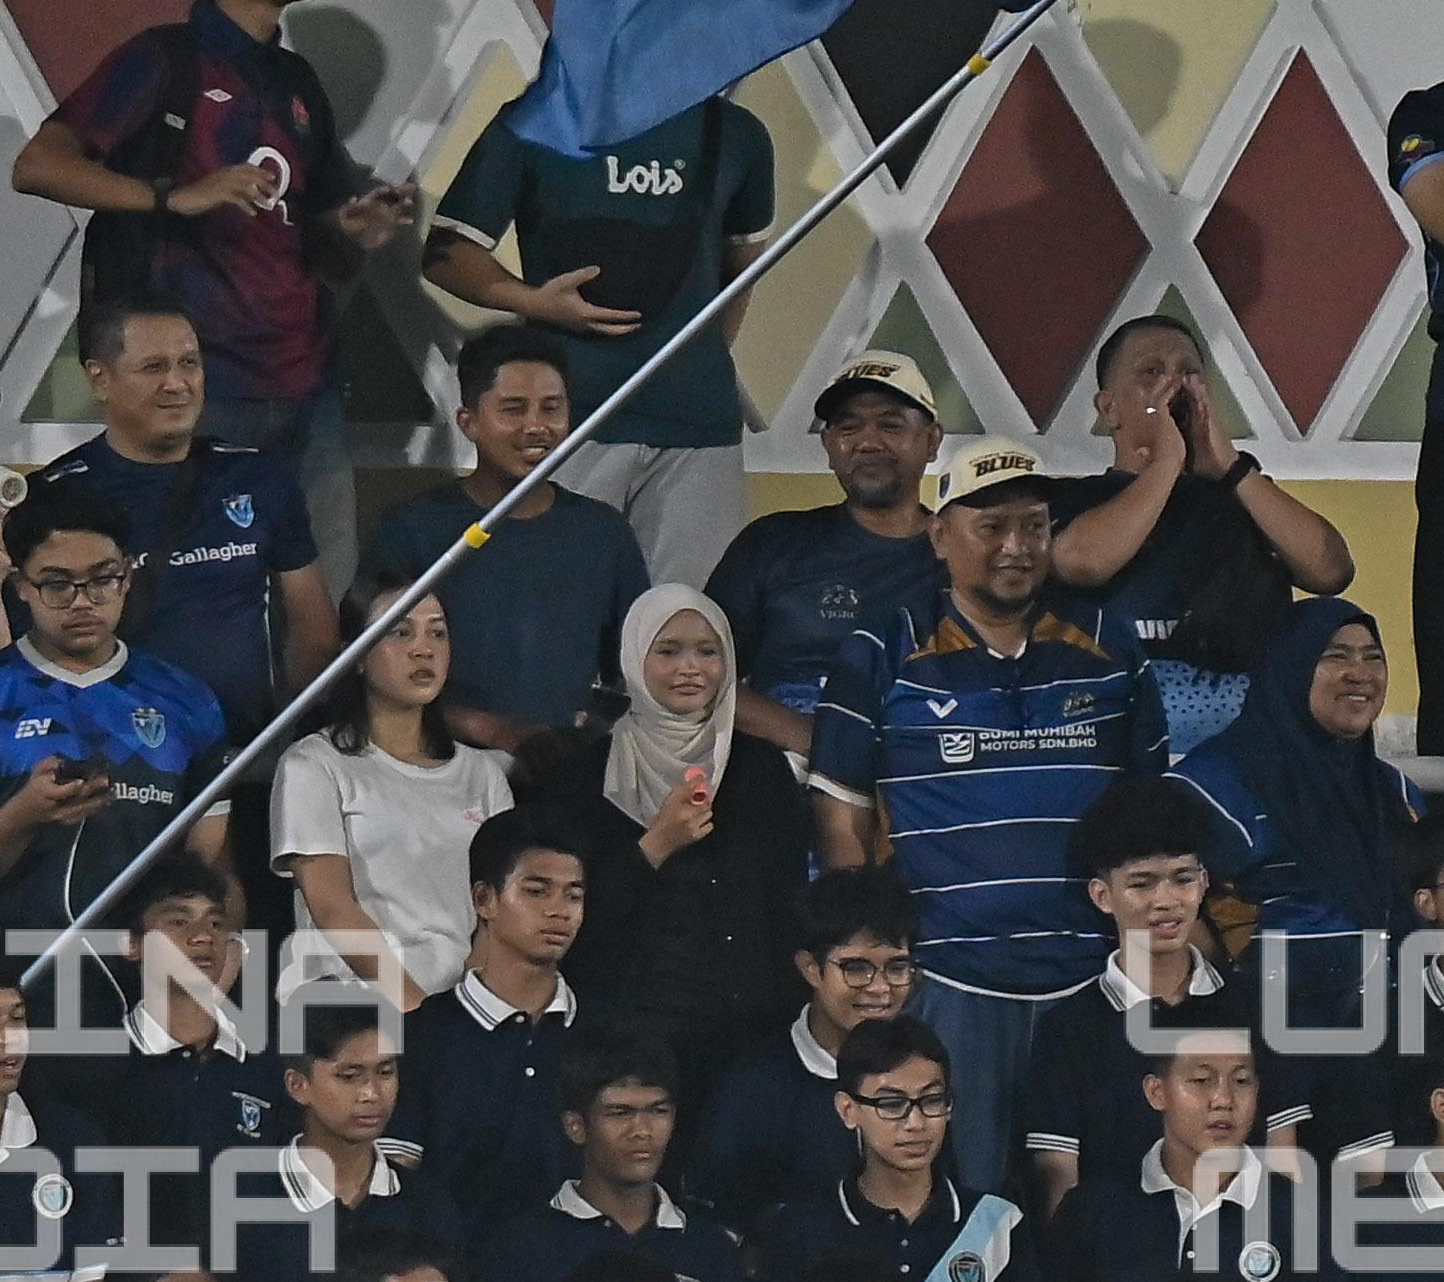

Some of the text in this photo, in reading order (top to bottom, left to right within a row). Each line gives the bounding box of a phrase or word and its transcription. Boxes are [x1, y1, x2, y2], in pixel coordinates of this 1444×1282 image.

[607, 155, 683, 195] Lois
[976, 455, 1036, 478] BLUES
[169, 542, 257, 565] Gallagher
[1024, 724, 1096, 738] MUHIBAH
[980, 739, 1036, 751] MOTORS
[110, 781, 174, 806] llagher
